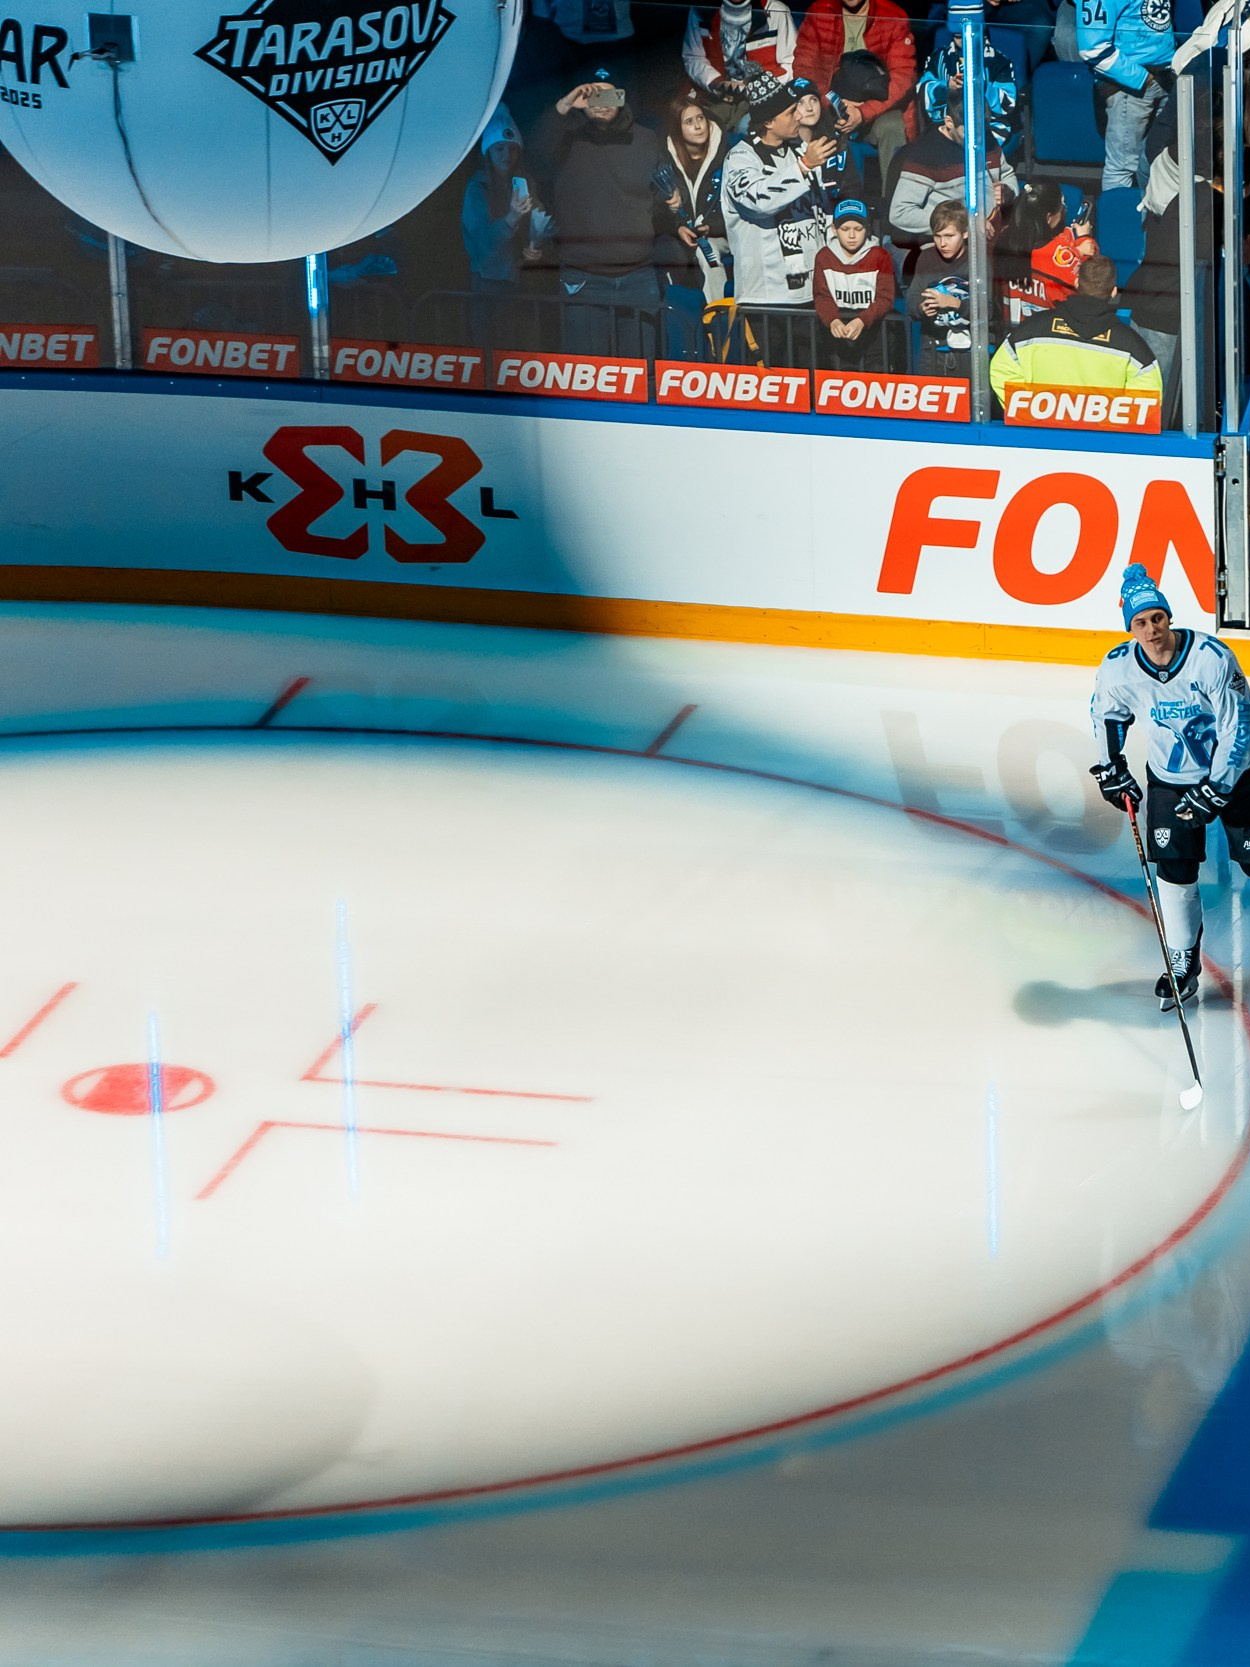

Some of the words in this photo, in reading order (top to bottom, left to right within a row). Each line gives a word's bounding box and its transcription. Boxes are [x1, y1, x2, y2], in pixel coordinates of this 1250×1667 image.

[1081, 0, 1107, 25] 54
[225, 0, 436, 67] TARASOV
[0, 18, 70, 88] AR
[268, 56, 406, 97] DIVISION
[0, 86, 42, 109] 2025
[835, 290, 872, 305] PUMA
[147, 337, 296, 371] FONBET
[334, 347, 481, 383] FONBET
[497, 359, 644, 394] FONBET
[659, 369, 807, 404] FONBET
[818, 379, 966, 413] FONBET
[1007, 390, 1157, 425] FONBET
[877, 466, 1215, 614] FON
